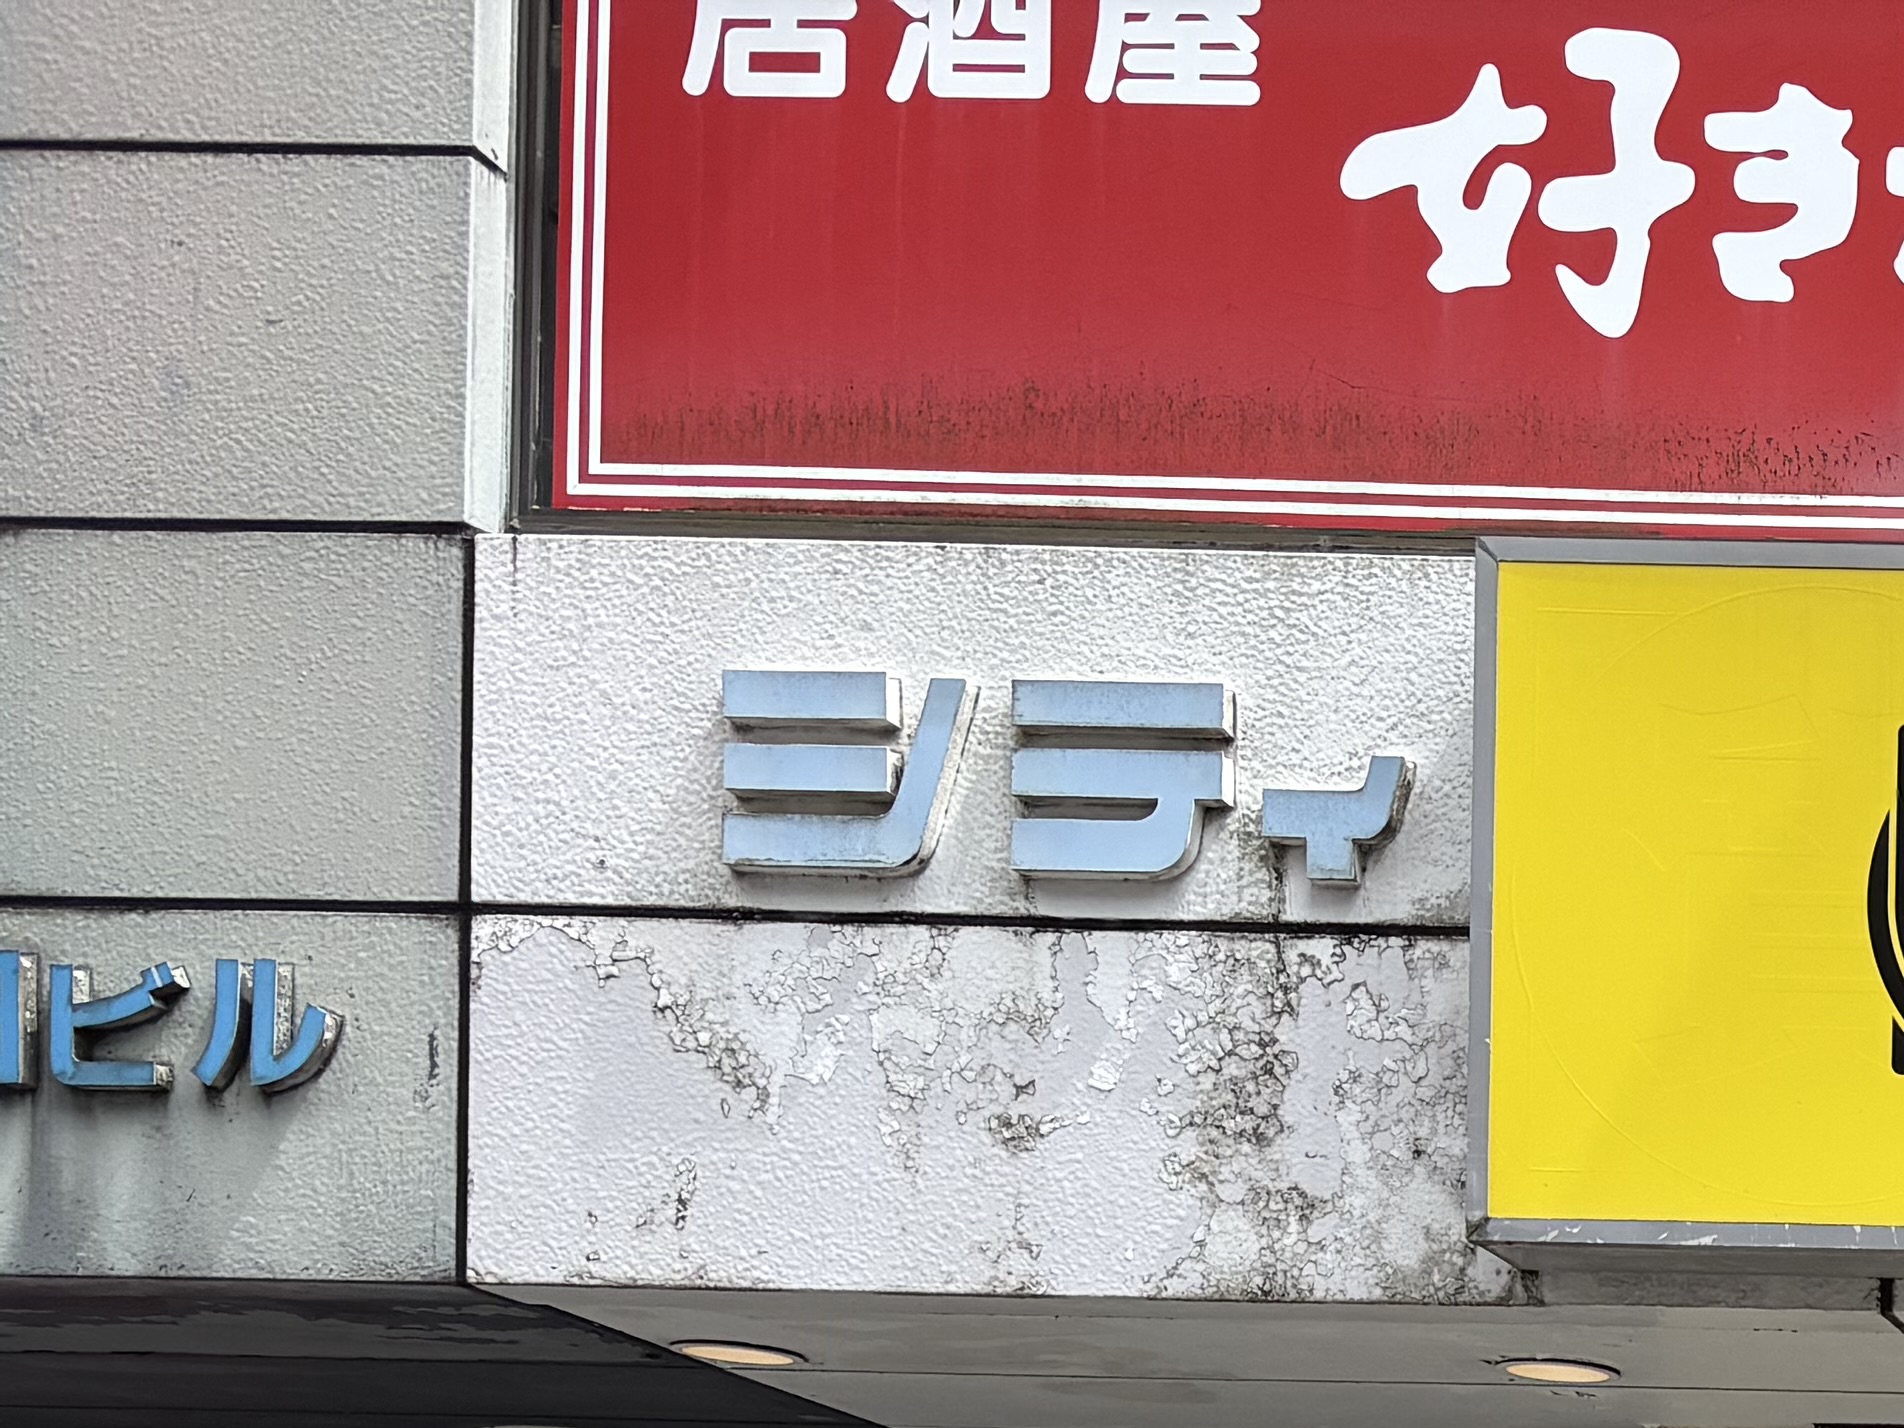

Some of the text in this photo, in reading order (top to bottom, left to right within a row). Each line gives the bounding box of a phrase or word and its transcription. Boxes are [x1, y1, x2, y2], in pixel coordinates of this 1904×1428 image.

[682, 0, 1261, 105] 居酒屋
[0, 951, 345, 1092] ビル
